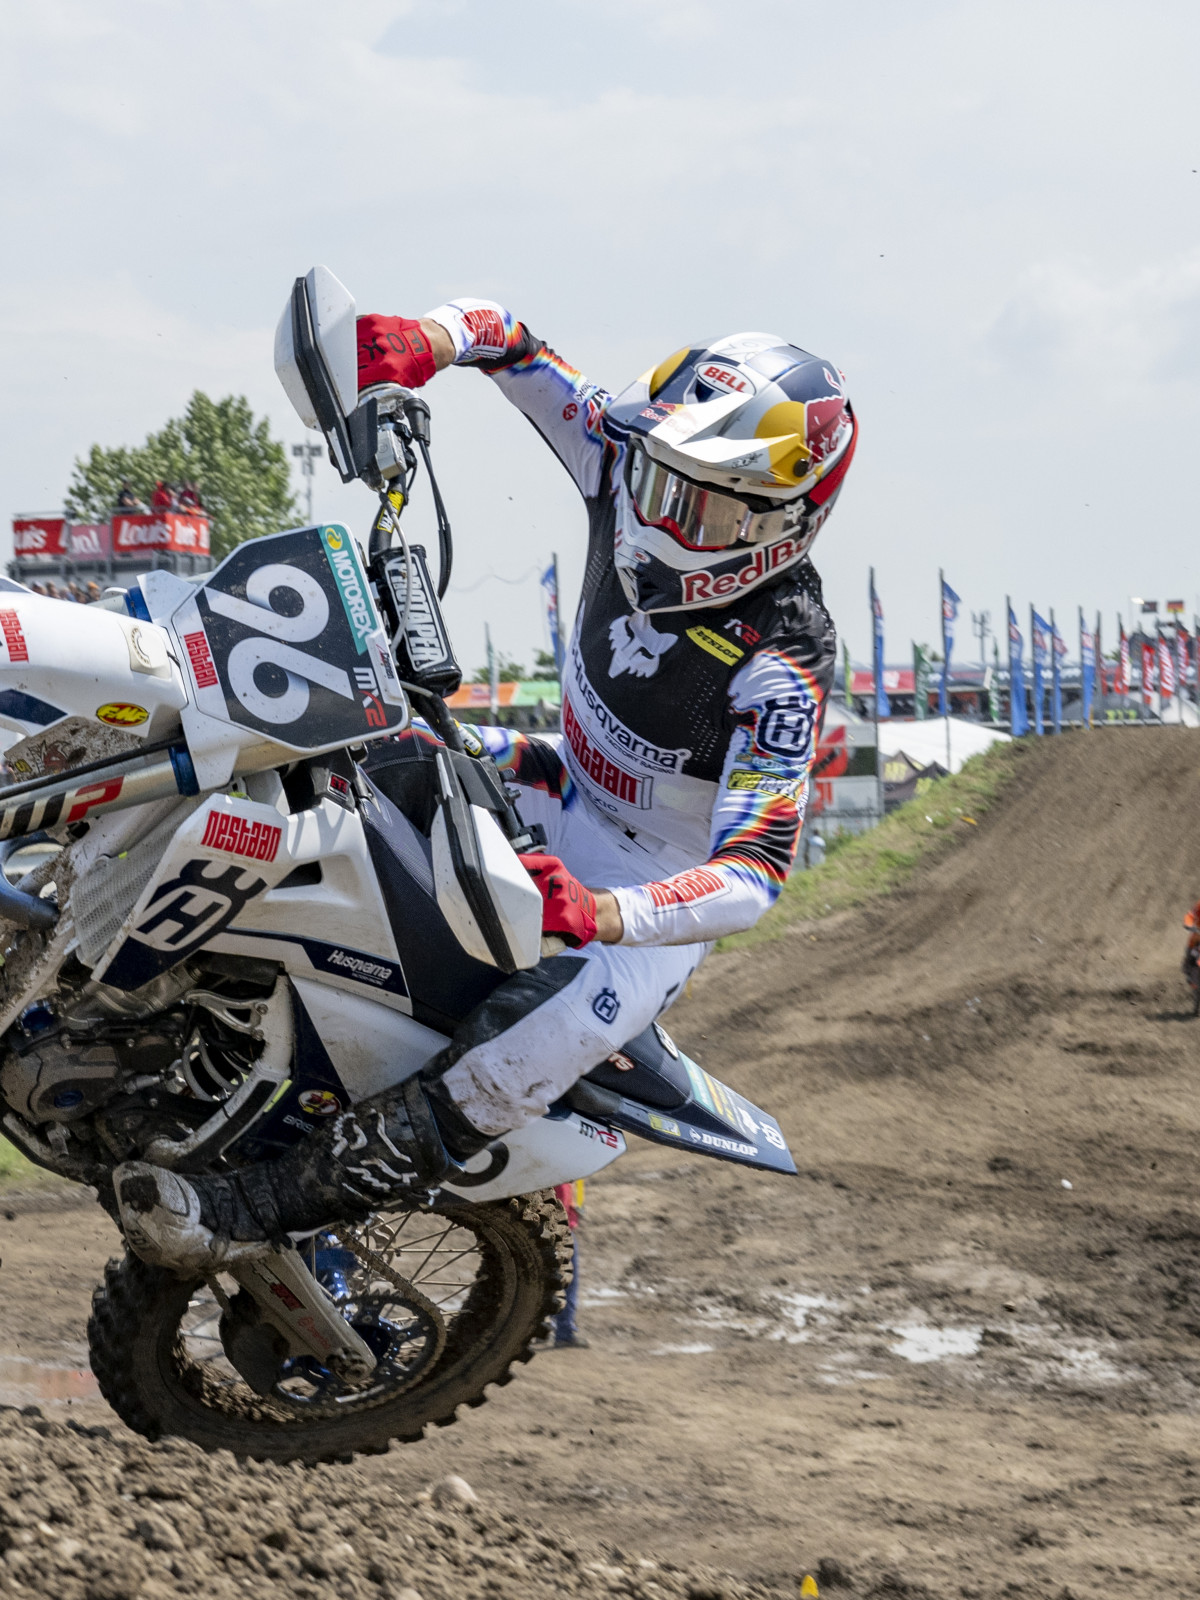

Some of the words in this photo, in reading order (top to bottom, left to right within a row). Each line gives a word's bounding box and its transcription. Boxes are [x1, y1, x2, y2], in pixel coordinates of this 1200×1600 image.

[362, 331, 425, 360] FOX
[704, 366, 747, 393] BELL
[332, 550, 374, 640] MOTOREX
[684, 550, 763, 602] Red
[204, 563, 354, 724] 96
[572, 648, 677, 770] Husqvarna
[201, 809, 282, 863] nestaan
[327, 949, 393, 979] Husqvarna
[701, 1132, 759, 1157] DUNLOP
